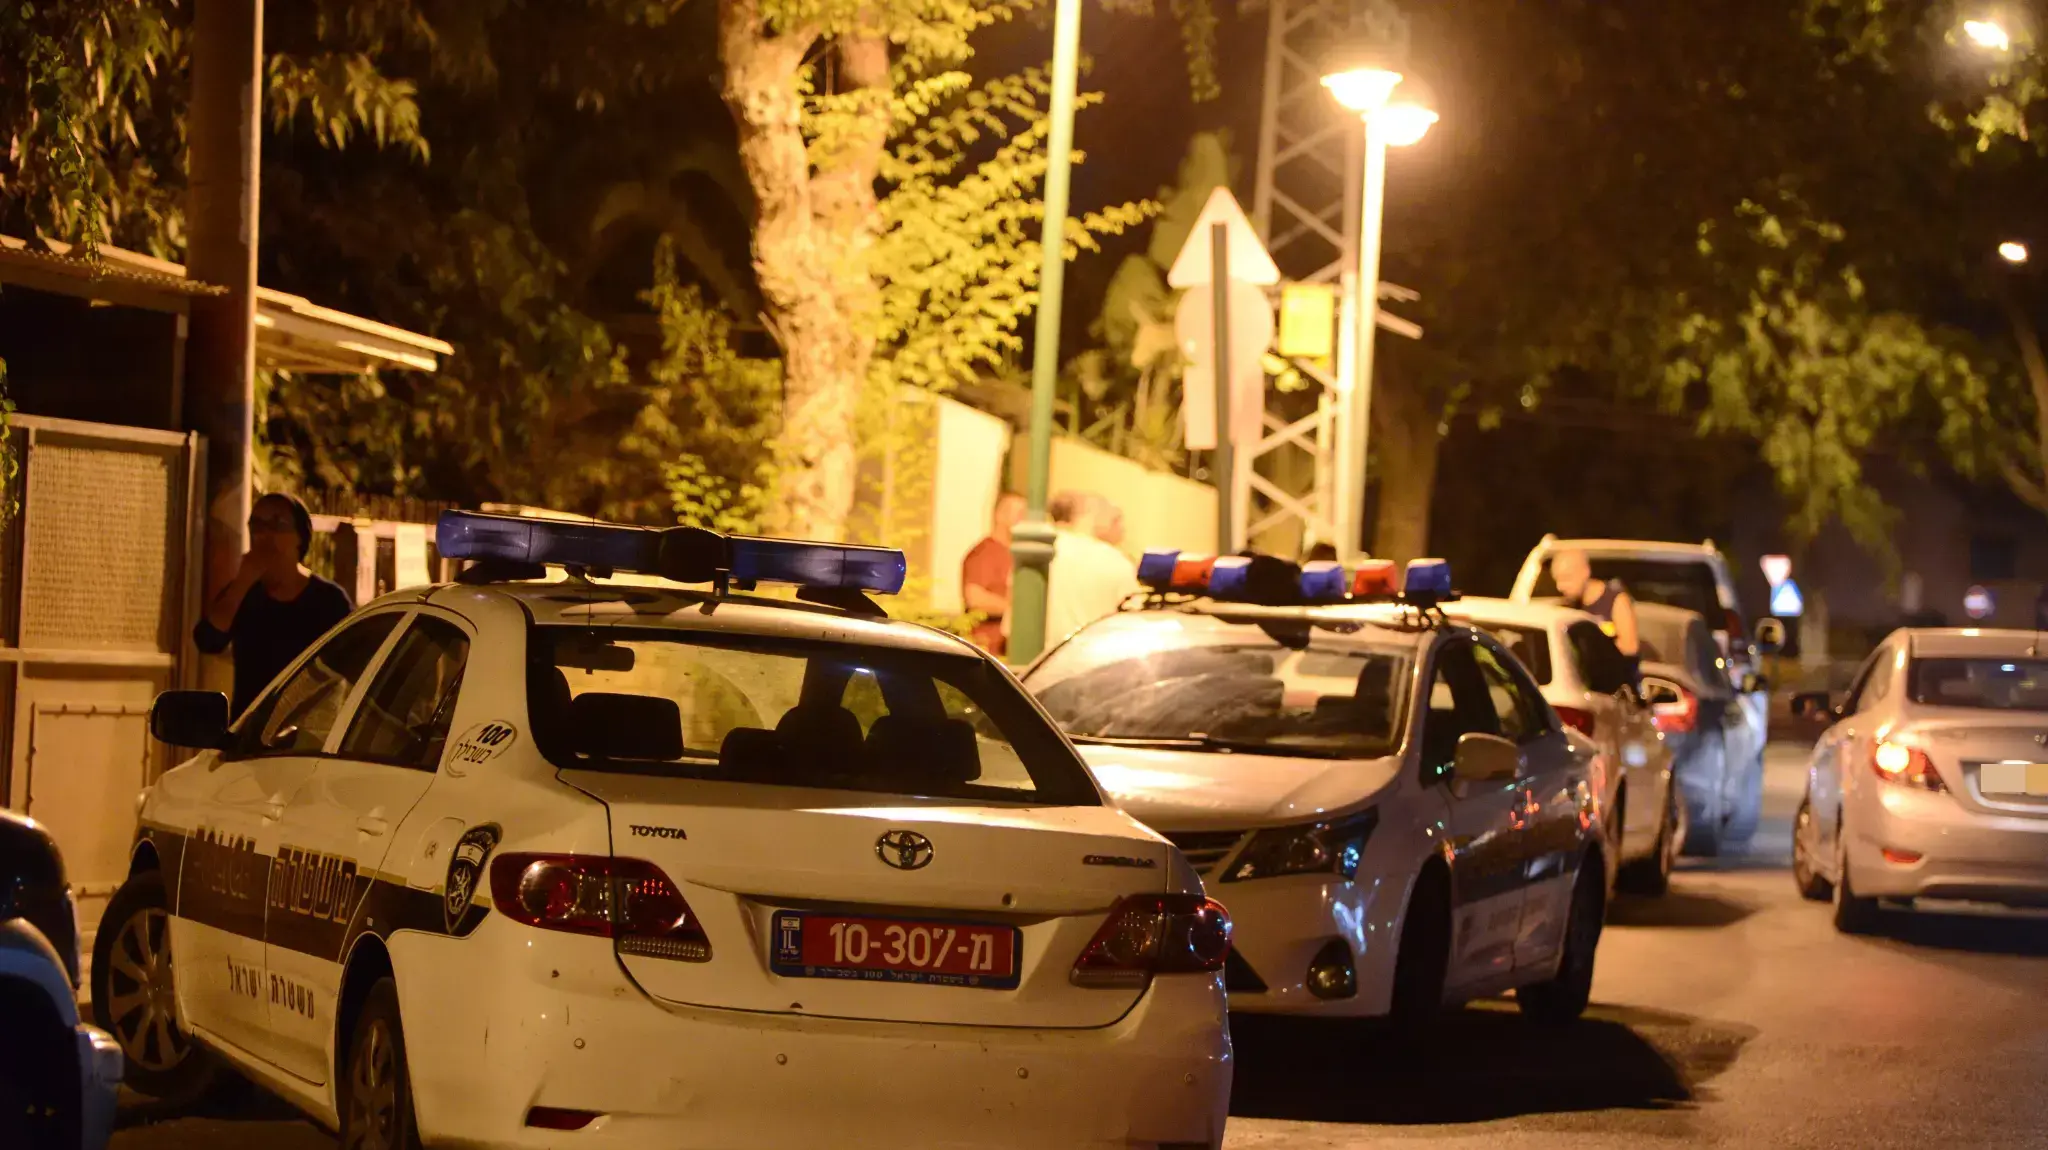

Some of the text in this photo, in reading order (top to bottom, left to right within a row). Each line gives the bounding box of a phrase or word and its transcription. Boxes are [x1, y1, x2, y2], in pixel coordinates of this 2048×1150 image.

[476, 724, 513, 746] 100
[450, 738, 493, 764] בשבילך
[629, 825, 688, 840] TOYOTA
[270, 843, 358, 925] משטרה
[782, 930, 797, 949] IL
[864, 970, 884, 980] 100
[226, 954, 315, 1020] משטרת ישראל
